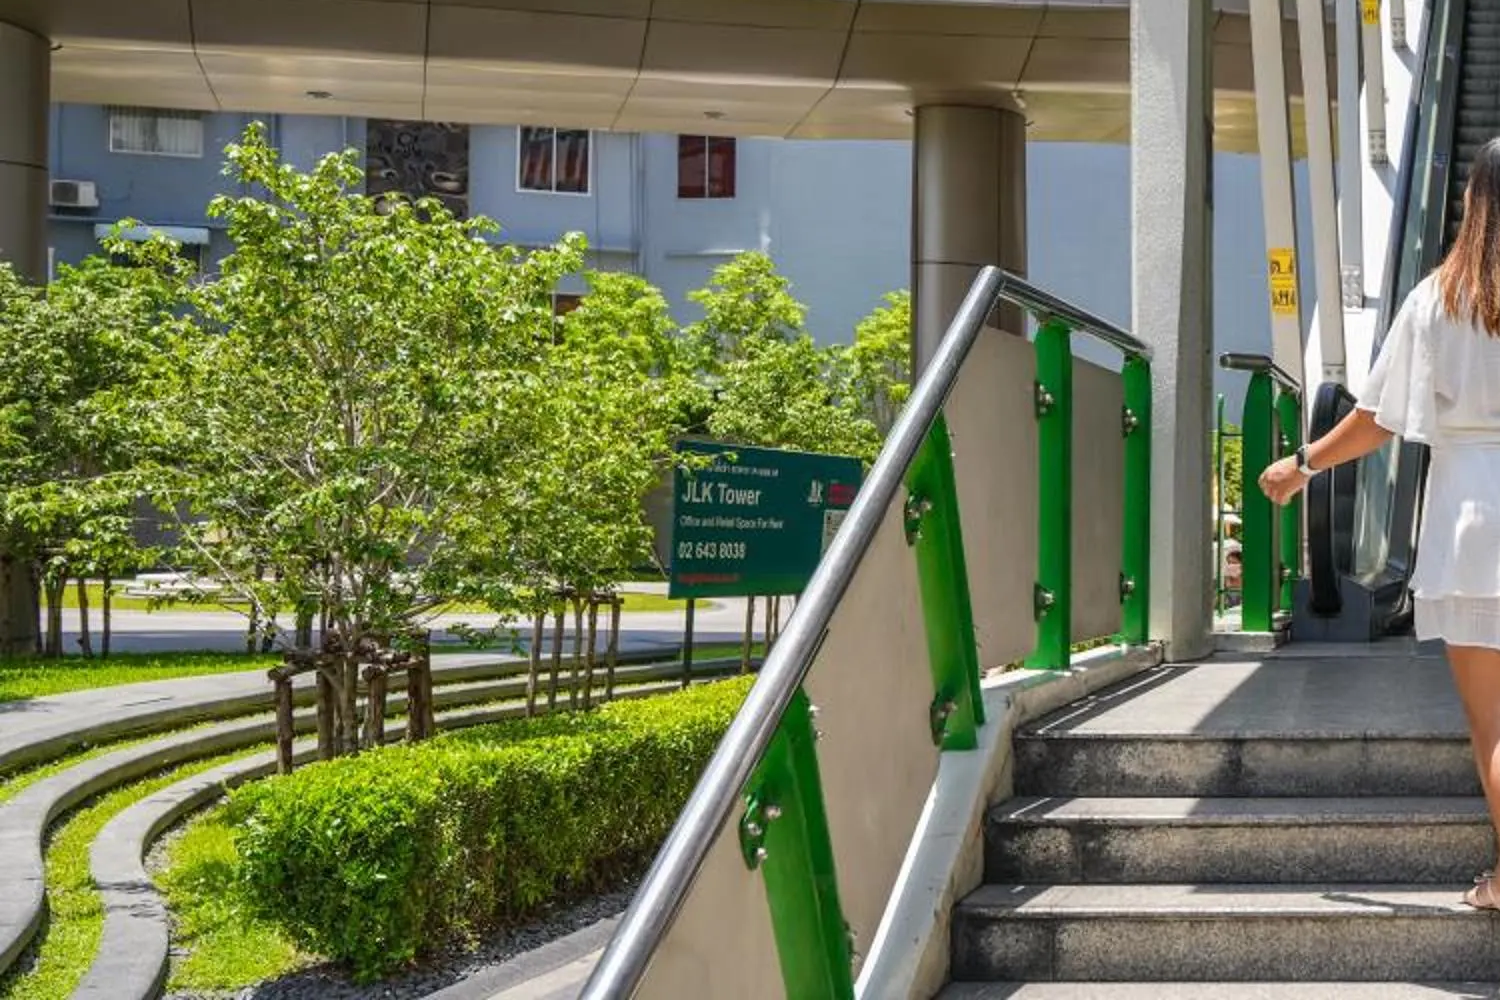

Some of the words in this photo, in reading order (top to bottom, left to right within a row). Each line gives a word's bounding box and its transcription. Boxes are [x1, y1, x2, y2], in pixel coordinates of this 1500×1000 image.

[681, 480, 713, 504] JLK
[717, 482, 762, 506] Tower
[678, 541, 693, 559] 02
[695, 541, 717, 560] 643
